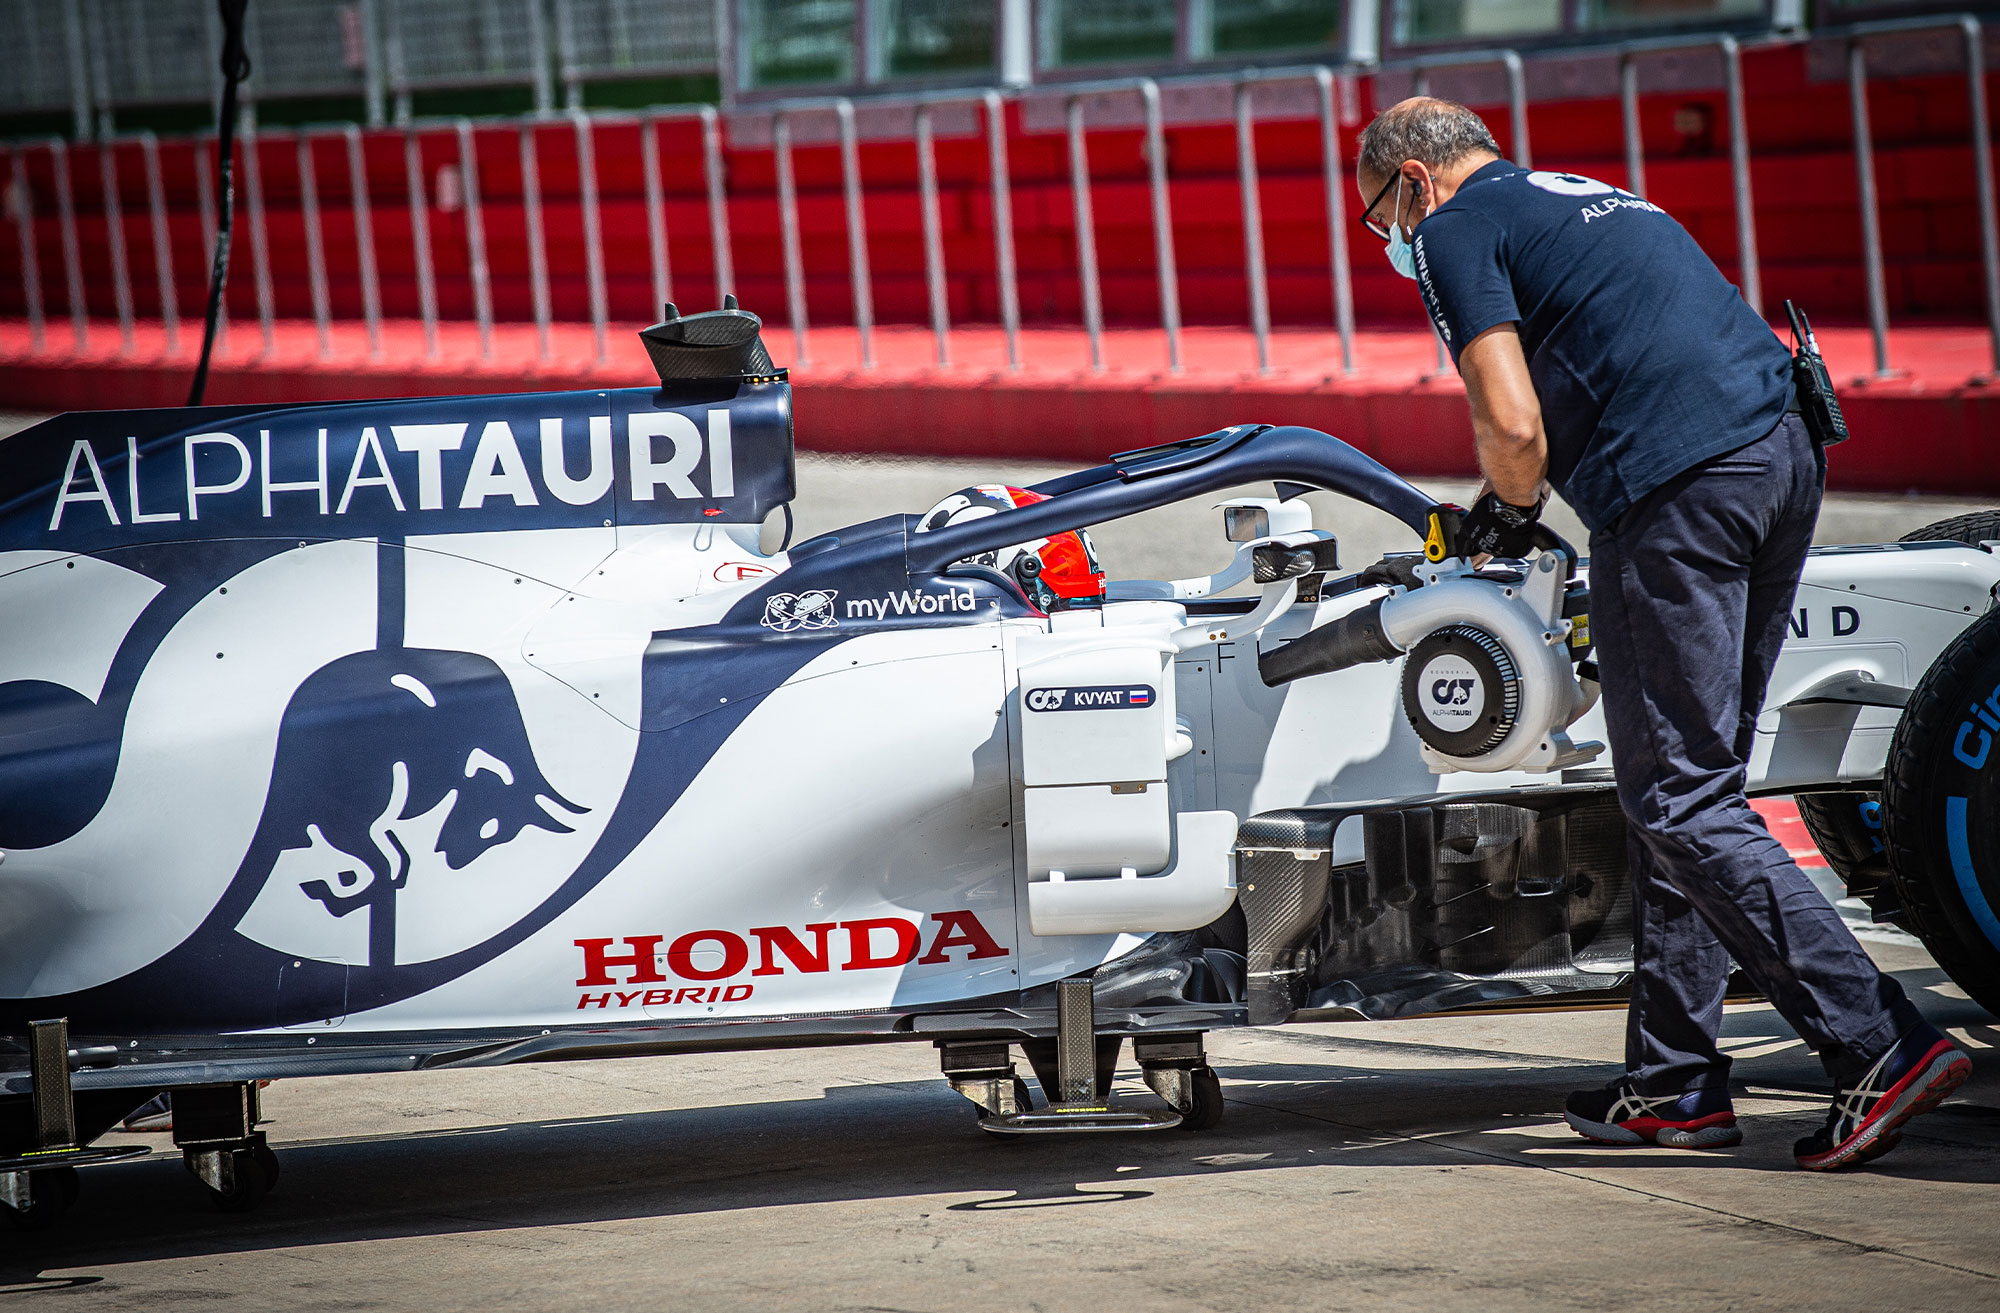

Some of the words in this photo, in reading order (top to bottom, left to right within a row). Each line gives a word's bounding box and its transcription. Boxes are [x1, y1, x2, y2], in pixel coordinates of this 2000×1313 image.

[48, 408, 735, 531] ALPHATAURI
[846, 587, 977, 621] myWorld
[1074, 690, 1124, 706] KVYAT
[1432, 709, 1472, 717] ALPHATAURI
[573, 910, 1010, 987] HONDA
[577, 984, 754, 1009] HYBRID
